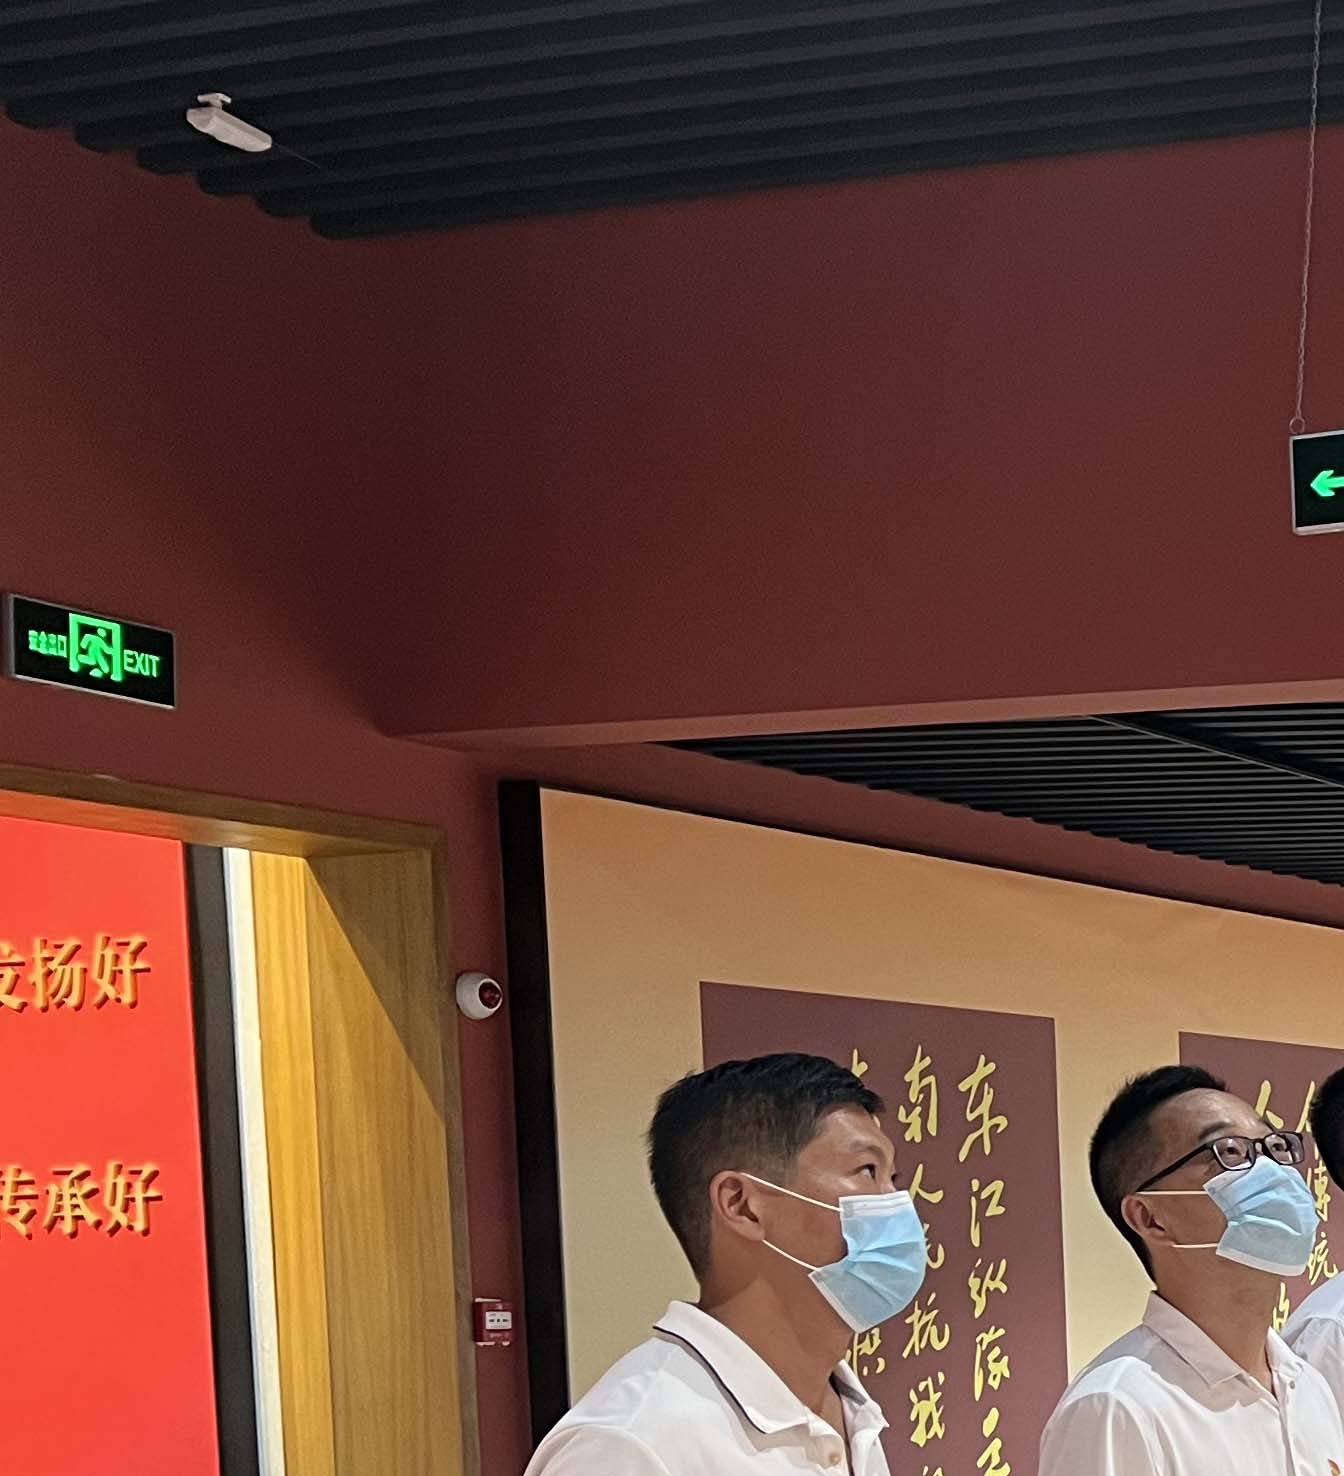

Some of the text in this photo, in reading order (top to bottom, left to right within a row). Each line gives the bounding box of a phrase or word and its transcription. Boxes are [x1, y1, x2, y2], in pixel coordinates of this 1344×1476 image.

[123, 648, 160, 678] EXIT
[0, 1158, 163, 1241] 传承好
